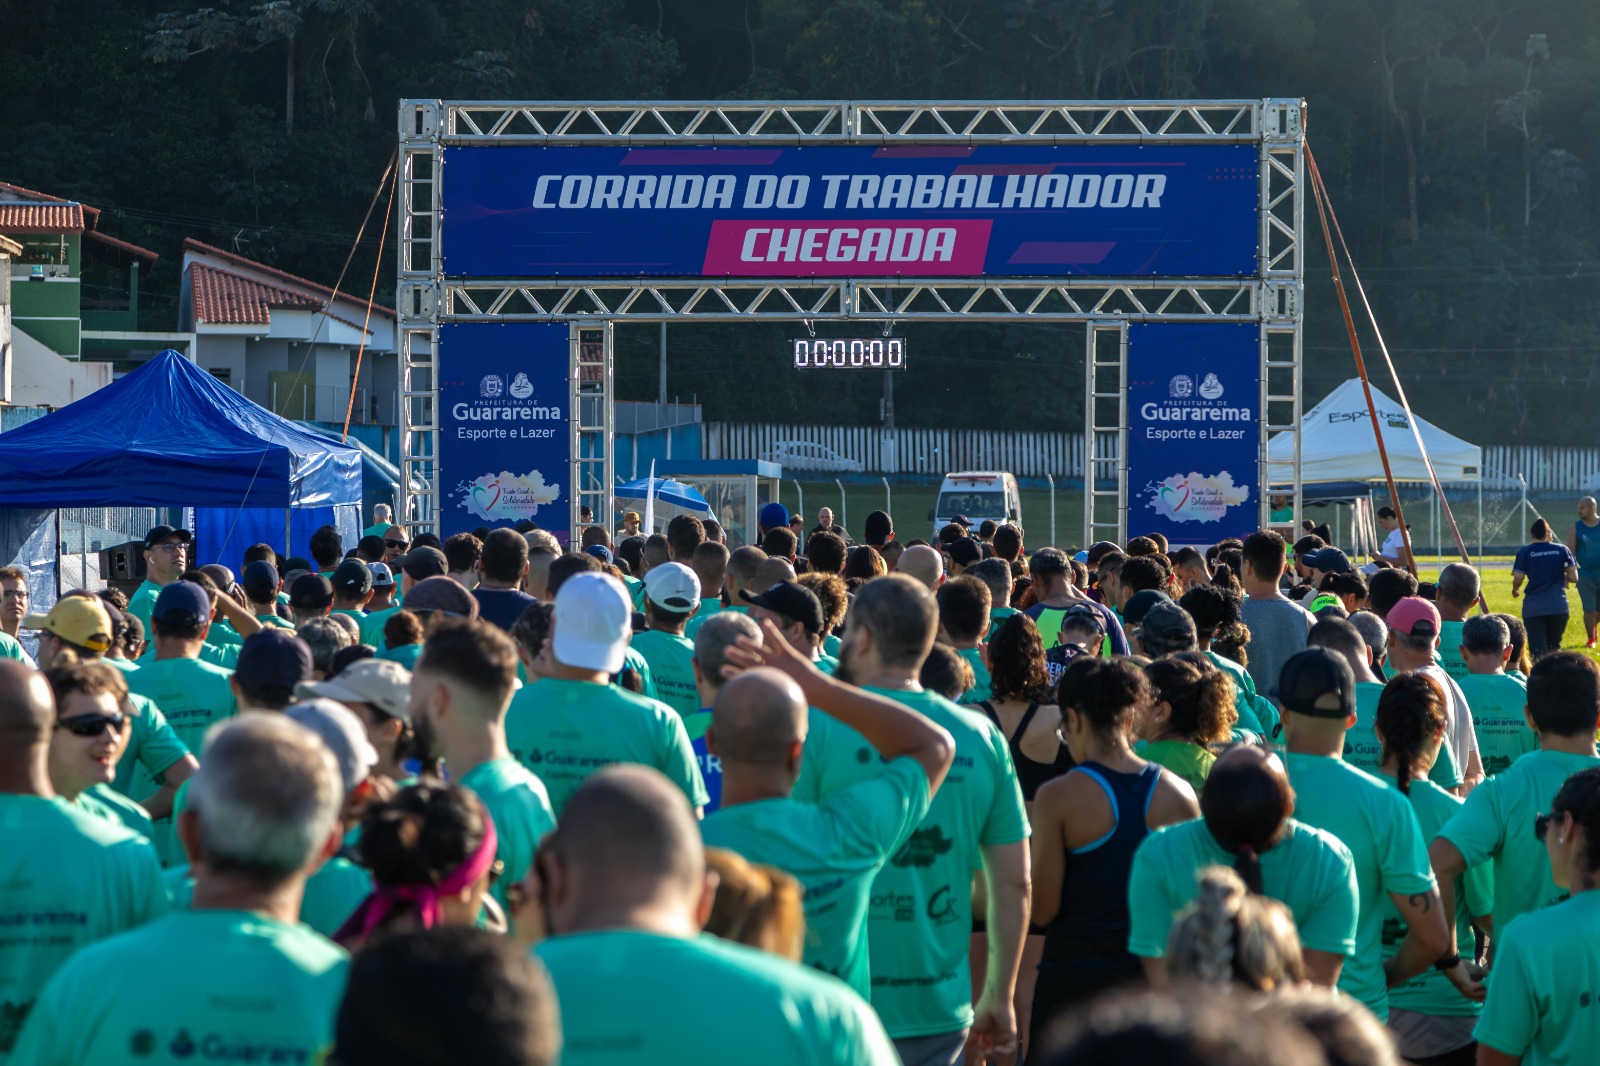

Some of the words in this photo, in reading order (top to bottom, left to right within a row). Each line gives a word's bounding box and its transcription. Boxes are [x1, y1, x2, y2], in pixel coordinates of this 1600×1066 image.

[532, 174, 738, 209] CORRIDA
[742, 174, 812, 209] DO
[820, 173, 1167, 209] TRABALHADOR
[740, 227, 957, 263] CHEGADA
[795, 340, 902, 367] 00:00:00
[452, 402, 561, 421] Guararema
[1141, 402, 1251, 422] Guararema
[1328, 408, 1408, 424] Espotes
[457, 427, 507, 441] Esporte
[509, 429, 518, 439] e
[520, 426, 556, 439] Lazer
[1146, 427, 1197, 441] Esporte
[1199, 430, 1207, 440] e
[1210, 427, 1246, 440] Lazer
[1530, 550, 1560, 558] Guararema
[1481, 717, 1526, 727] Guararema
